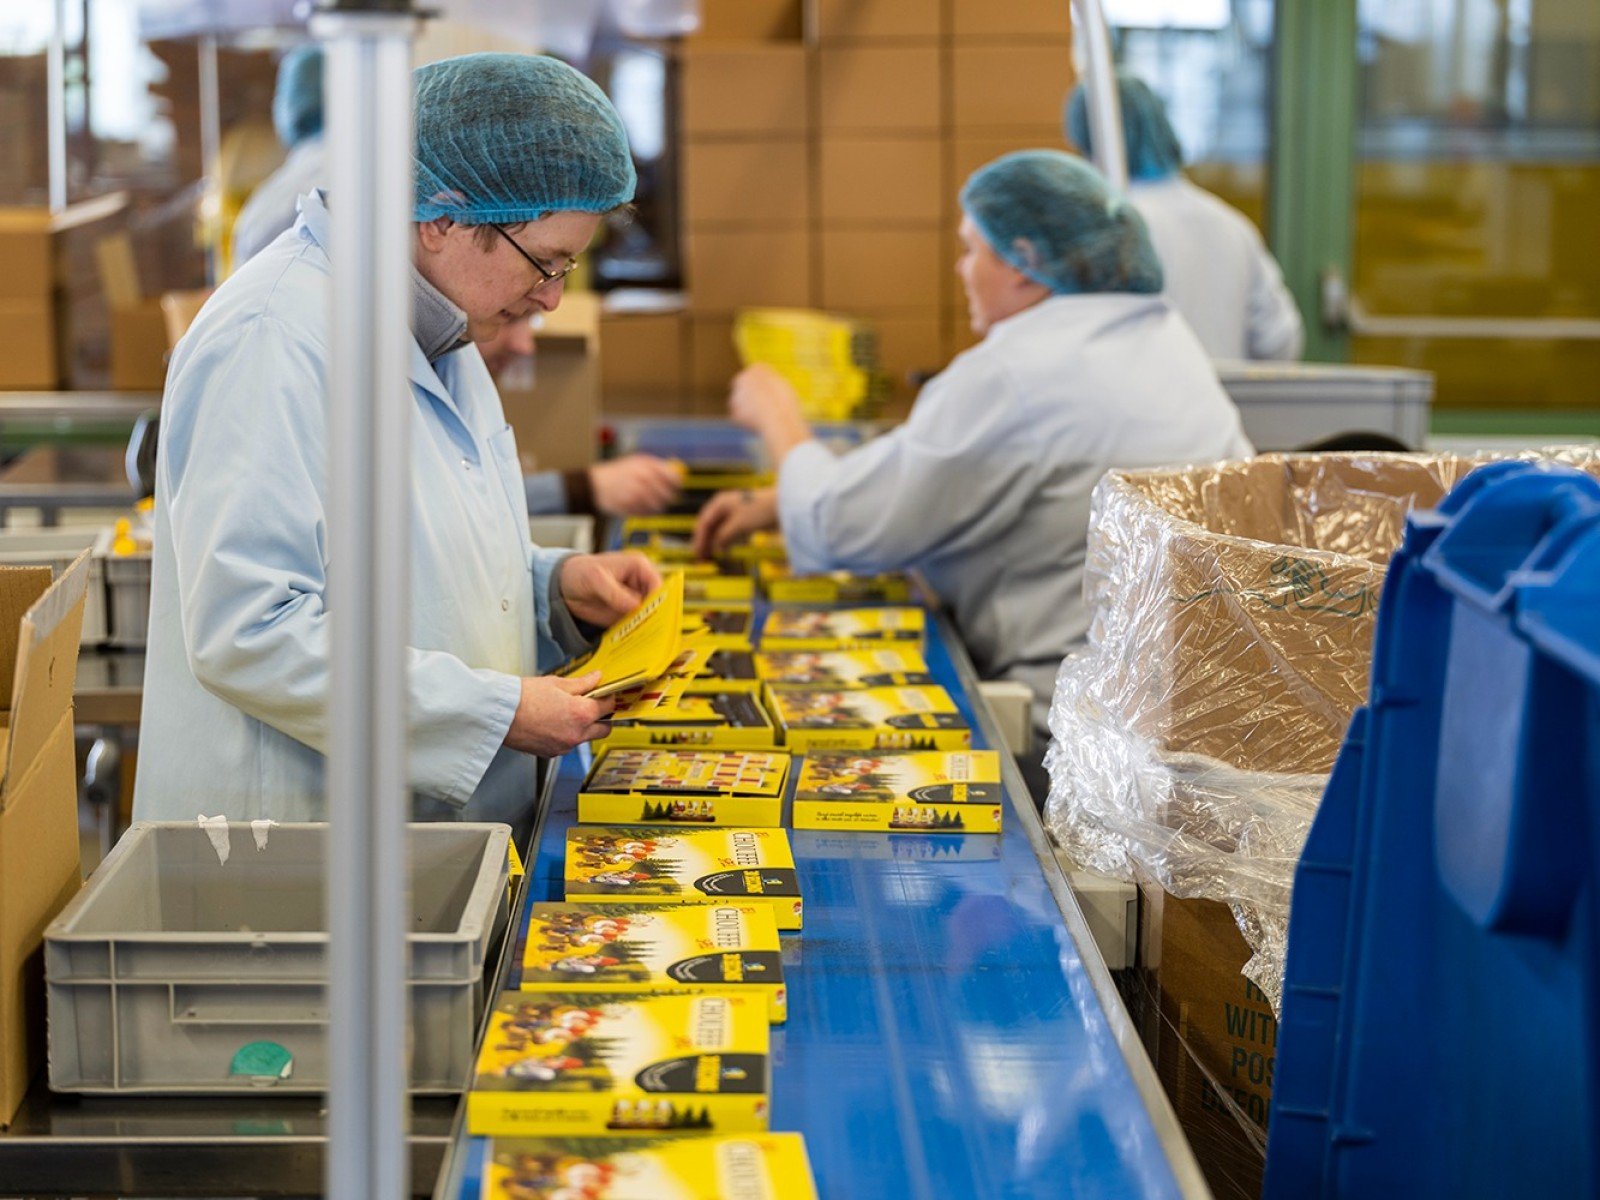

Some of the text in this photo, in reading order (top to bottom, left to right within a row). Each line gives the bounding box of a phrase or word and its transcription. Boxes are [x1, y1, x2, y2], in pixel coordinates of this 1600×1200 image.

[733, 832, 759, 865] CHOUFFE
[715, 908, 741, 947] CHOUFFE
[1201, 1078, 1271, 1128] BEFO
